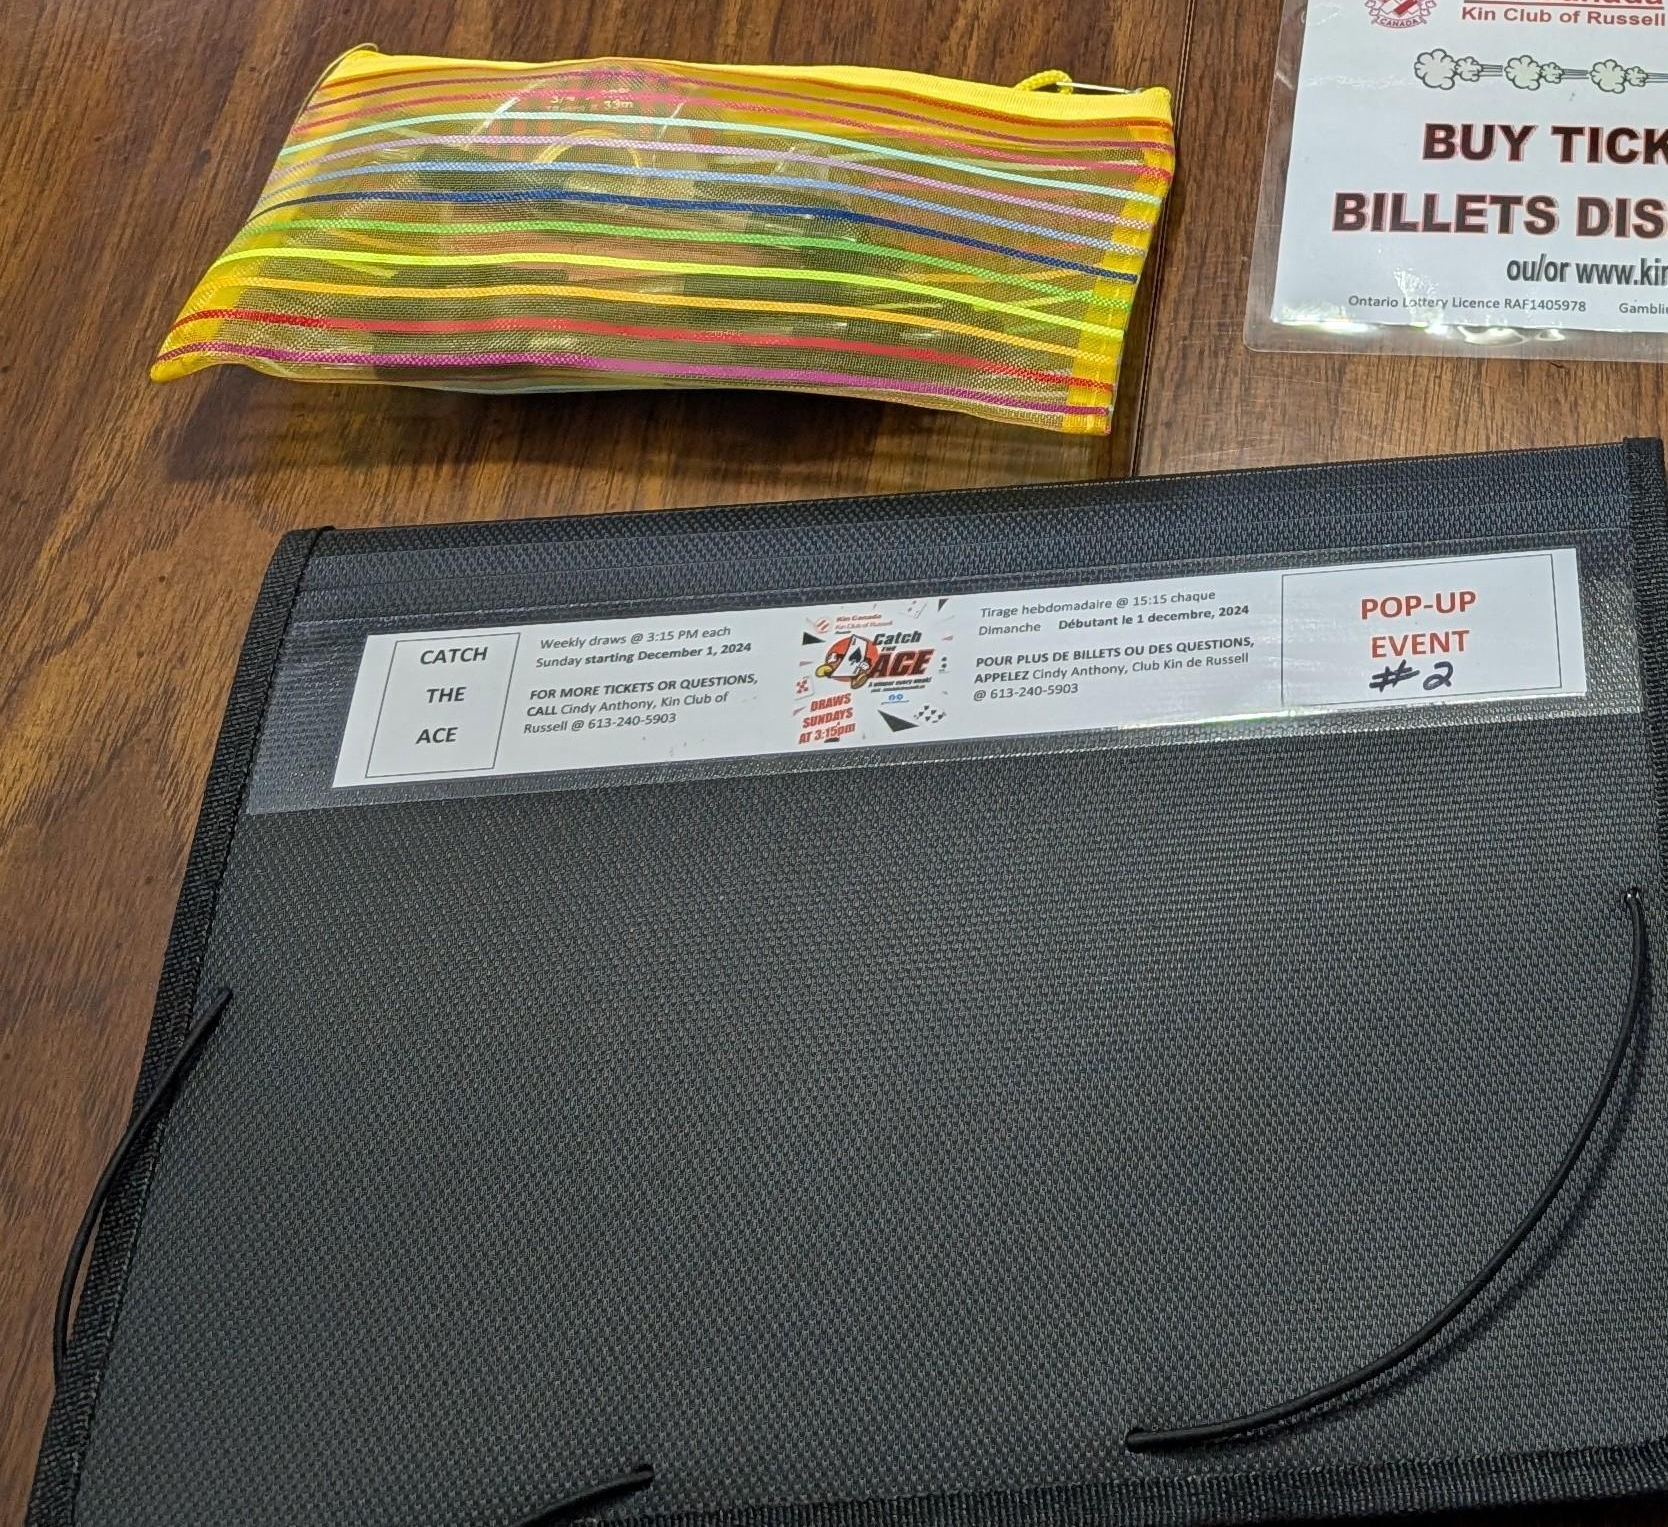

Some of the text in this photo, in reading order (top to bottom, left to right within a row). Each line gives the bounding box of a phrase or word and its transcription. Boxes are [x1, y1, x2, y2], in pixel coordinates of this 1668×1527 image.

[1461, 6, 1666, 27] Kin Club of Russell
[1423, 123, 1535, 161] BUY
[1333, 192, 1556, 235] BILLETS
[1506, 253, 1571, 283] ou/or
[1347, 294, 1587, 313] Ontario Lottery Licence RAF1405978
[980, 591, 1216, 619] Tirage hebdomadaire @ 15:15 chaque
[1361, 590, 1477, 620] POP-UP
[540, 625, 731, 650] Weekly draws @ 3:15 PM each
[1371, 629, 1470, 659] EVENT
[420, 646, 489, 665] CATCH
[426, 686, 467, 704] THE
[529, 673, 758, 701] FOR MORE TICKETS OR QUESTIONS,
[803, 708, 853, 728] SUNDAYS
[415, 726, 459, 745] ACE
